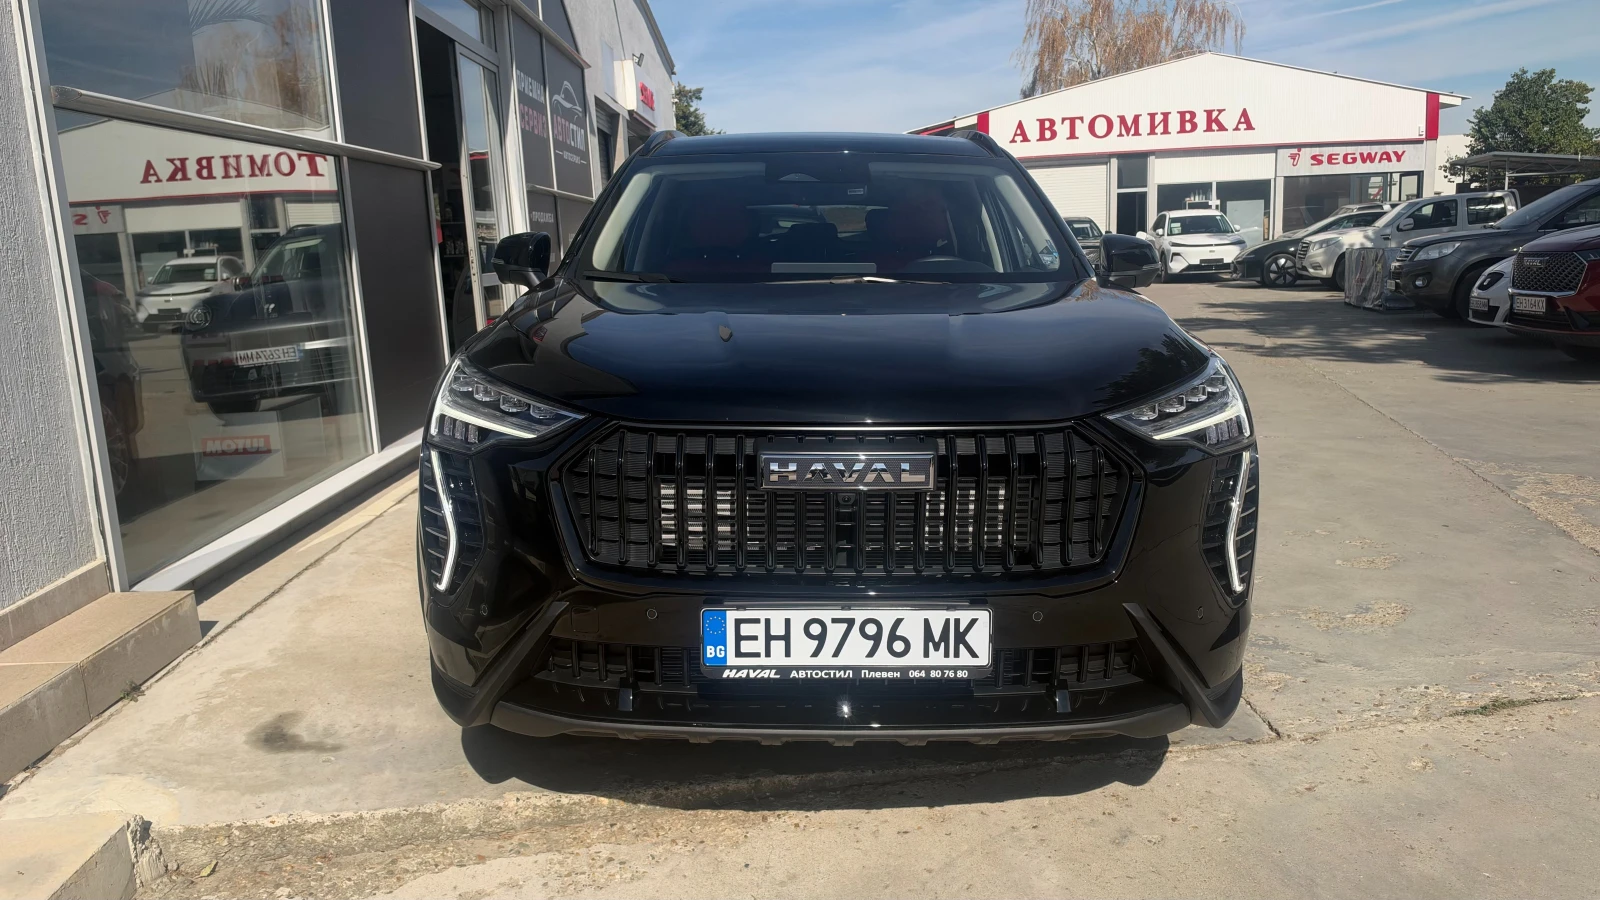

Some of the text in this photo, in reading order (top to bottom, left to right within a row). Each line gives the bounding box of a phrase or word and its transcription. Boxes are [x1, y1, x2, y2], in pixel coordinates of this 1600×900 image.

[553, 114, 586, 152] АВТОСТИЛ
[1009, 107, 1256, 144] АВТОМИВКА
[1310, 150, 1407, 167] SEGWAY
[206, 438, 268, 454] MOTUL
[769, 462, 926, 483] HAVAL
[734, 617, 980, 658] EH 9796 MK
[706, 645, 725, 658] BG
[722, 669, 968, 679] HAVAL АВТОСТИЛ Плевен 064 80 76 80
